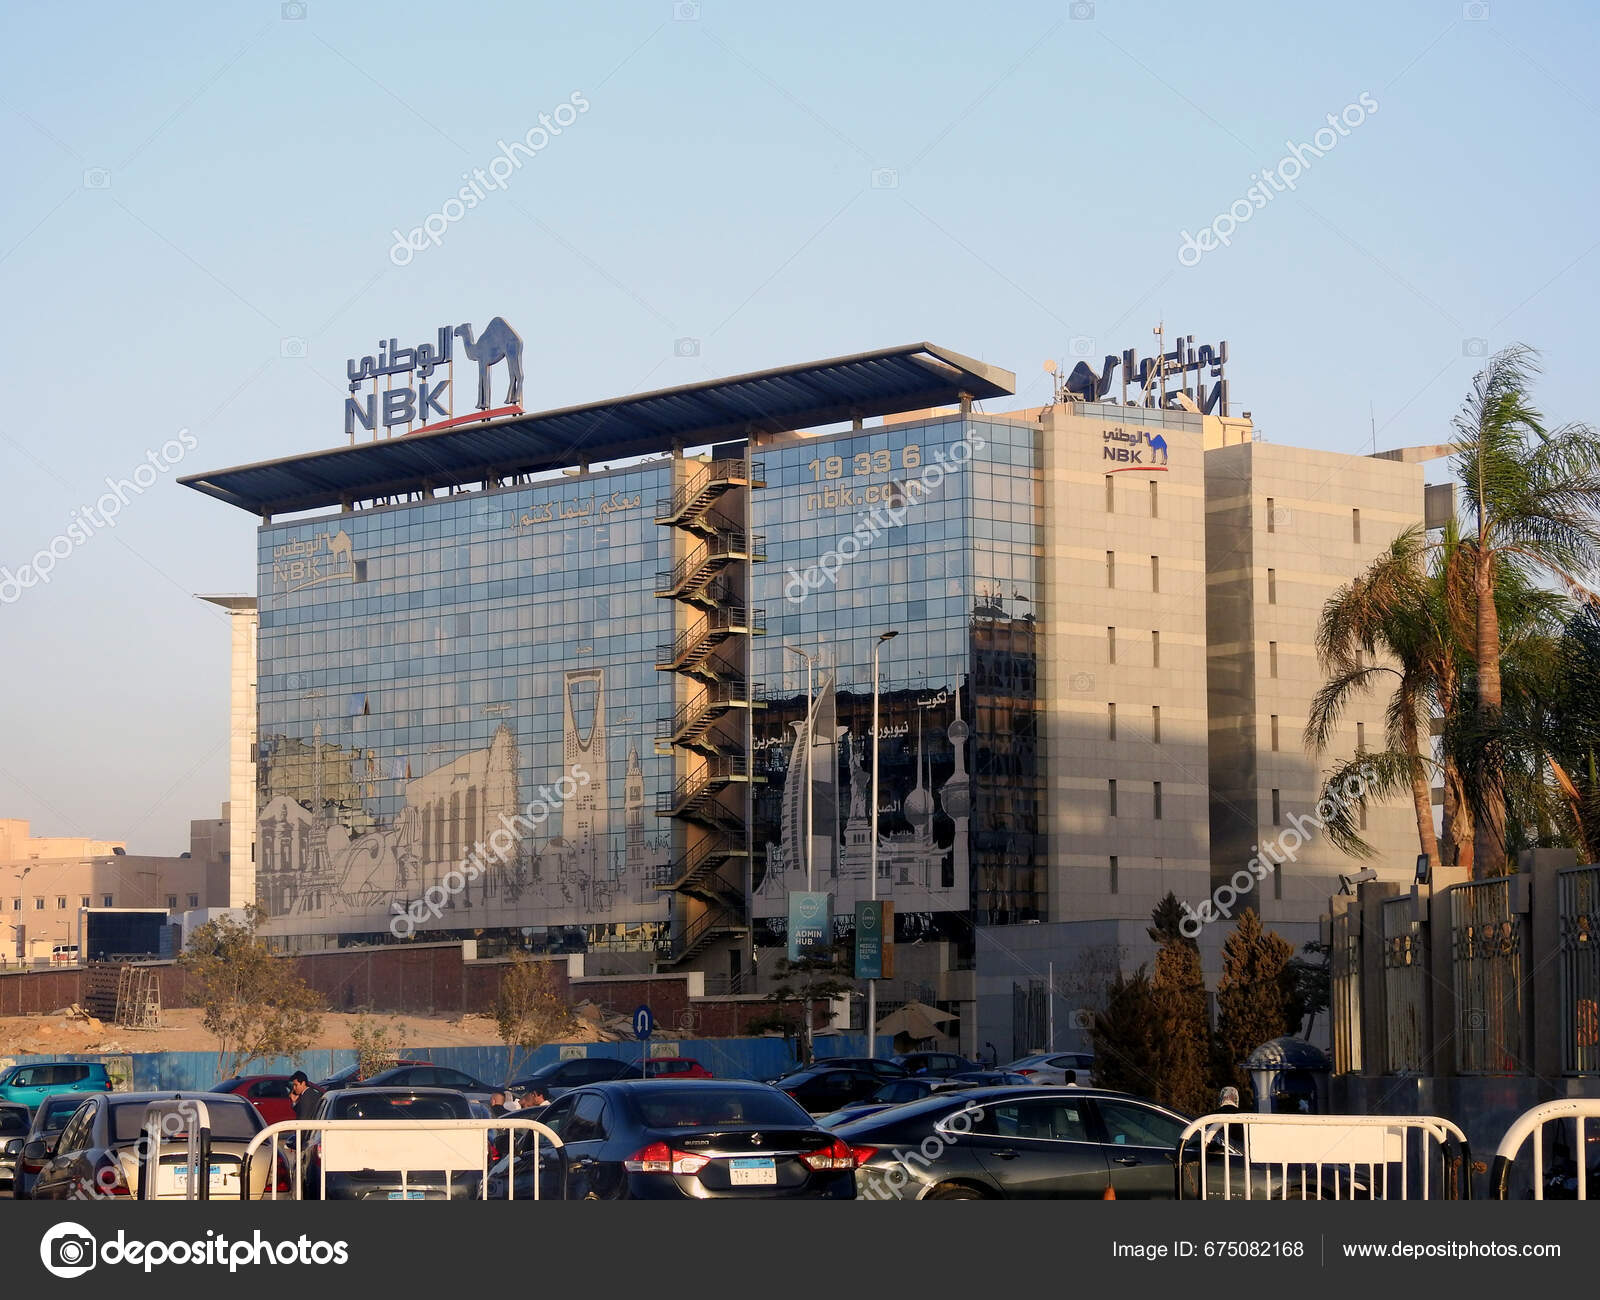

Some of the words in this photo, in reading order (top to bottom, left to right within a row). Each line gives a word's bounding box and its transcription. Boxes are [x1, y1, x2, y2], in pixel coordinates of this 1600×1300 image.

[347, 325, 453, 391] الوطني
[345, 380, 451, 434] NBK
[1103, 428, 1143, 446] الوطني
[808, 455, 843, 481] 19
[854, 449, 891, 476] 33
[902, 444, 921, 469] 6
[1103, 446, 1143, 464] NBK
[273, 532, 323, 559] الوطني
[273, 557, 321, 584] NBK
[917, 691, 947, 709] لكويت
[795, 930, 822, 938] ADMIN
